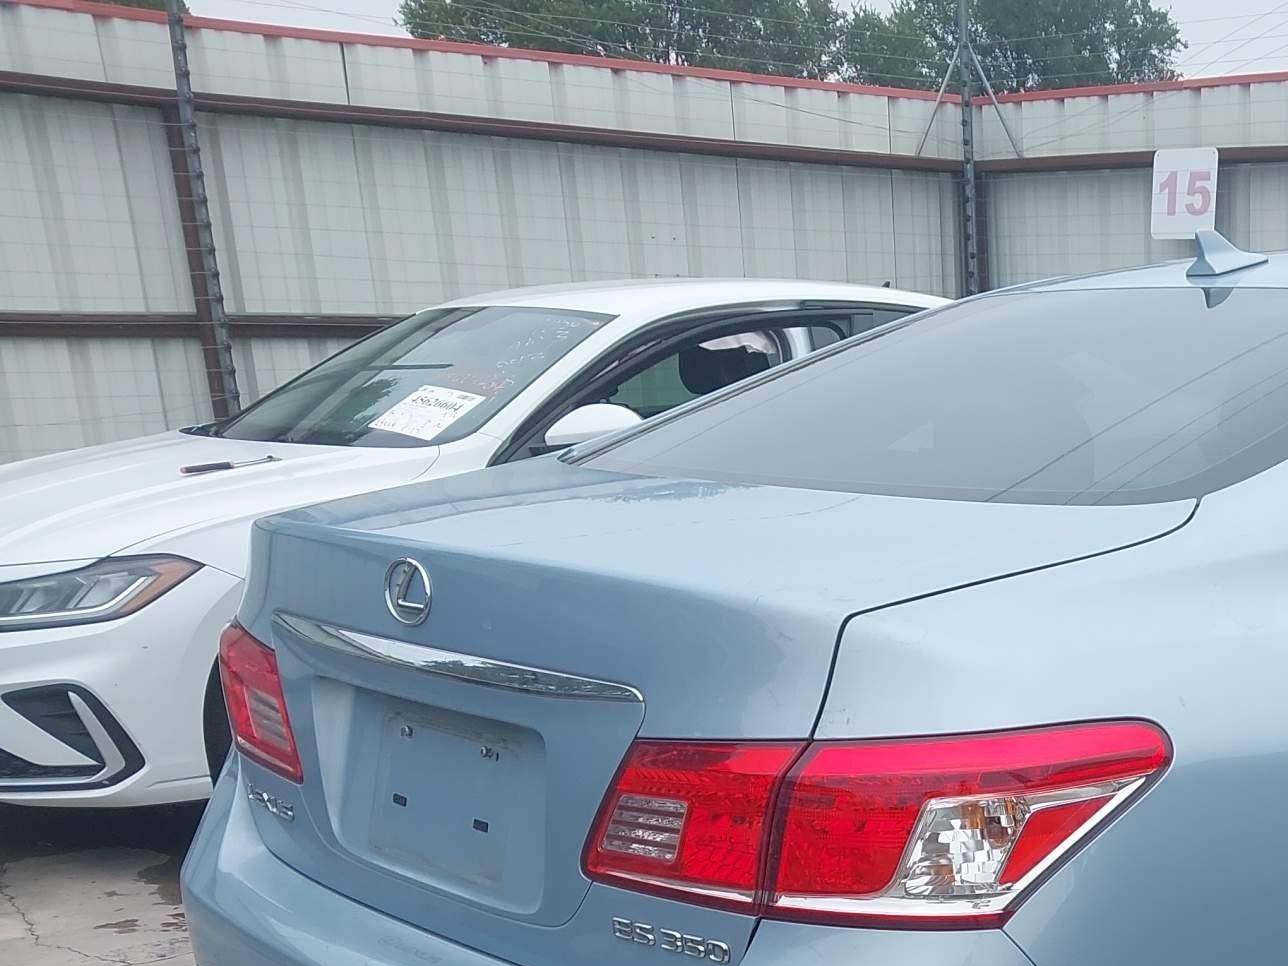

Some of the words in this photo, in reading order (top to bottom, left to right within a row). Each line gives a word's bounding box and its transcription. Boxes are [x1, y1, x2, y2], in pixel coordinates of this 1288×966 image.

[1159, 170, 1211, 217] 15
[611, 916, 656, 945] ES
[660, 928, 731, 964] 350
